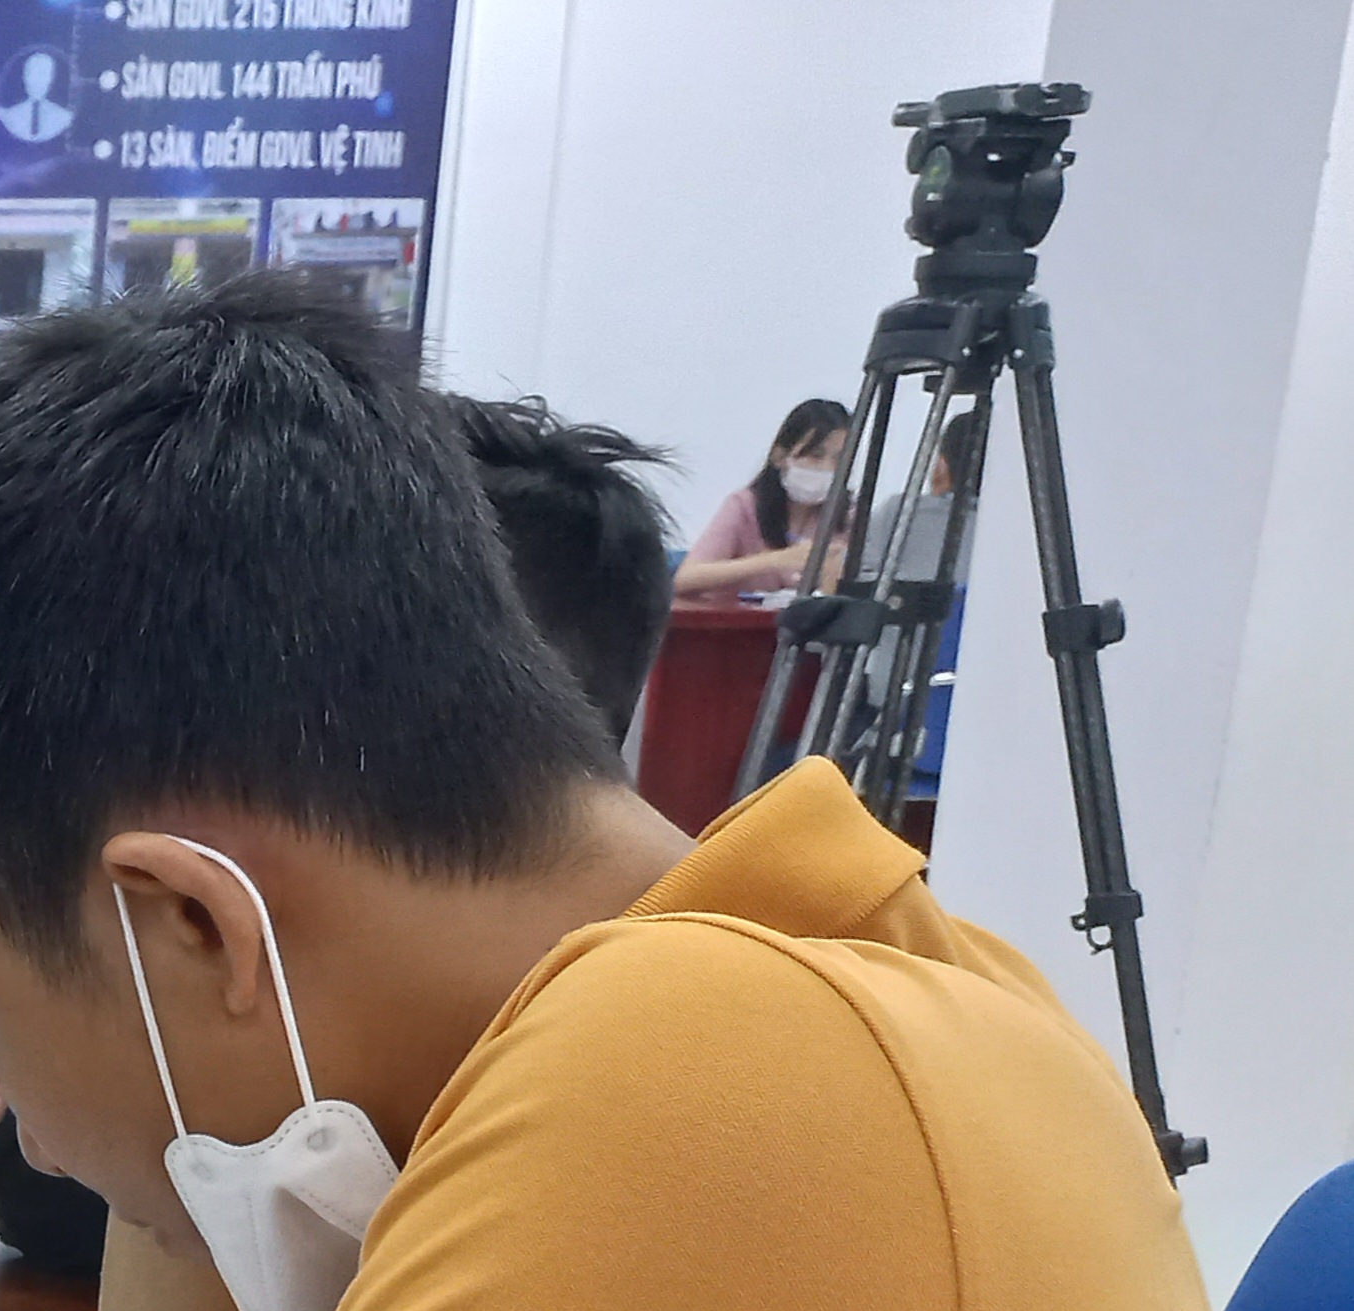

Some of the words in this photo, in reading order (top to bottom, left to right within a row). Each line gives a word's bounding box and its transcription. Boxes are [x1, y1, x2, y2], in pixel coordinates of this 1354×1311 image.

[232, 61, 273, 99] 144
[121, 131, 146, 169] 13
[353, 131, 406, 169] TINH
